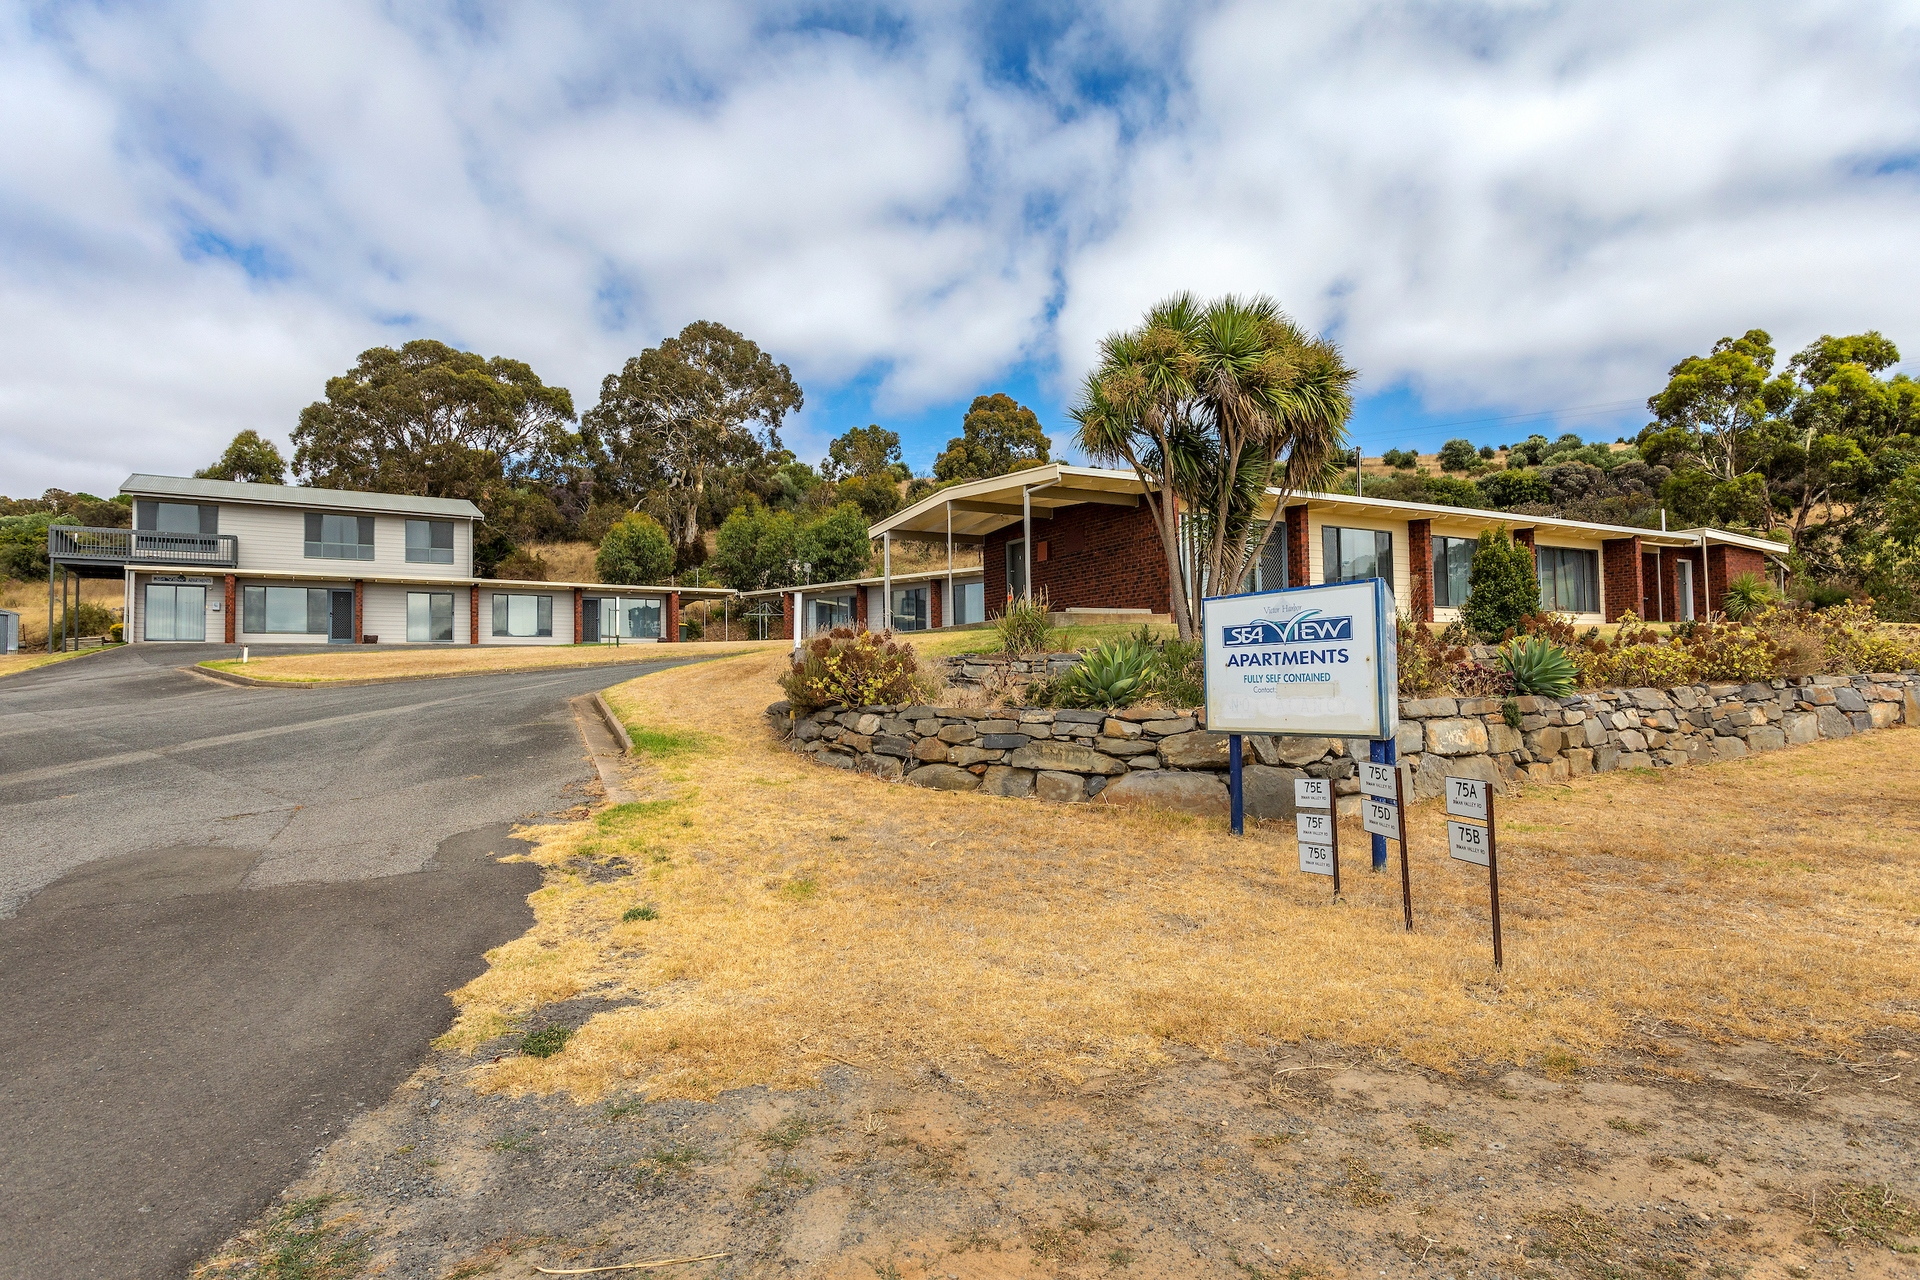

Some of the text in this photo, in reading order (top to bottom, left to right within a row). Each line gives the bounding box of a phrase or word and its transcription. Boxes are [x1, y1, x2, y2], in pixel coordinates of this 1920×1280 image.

[1263, 603, 1302, 614] Victor Harbor
[1226, 626, 1264, 644] SEA
[1228, 648, 1349, 667] APARTMENTS
[1243, 672, 1331, 683] FULLY SELF CONTAINED
[1369, 766, 1387, 781] 75C
[1304, 782, 1322, 793] 75E
[1456, 782, 1477, 799] 75A
[1372, 804, 1390, 820] 75D
[1306, 816, 1323, 828] 75F
[1458, 827, 1480, 844] 75B
[1308, 847, 1326, 860] 75G
